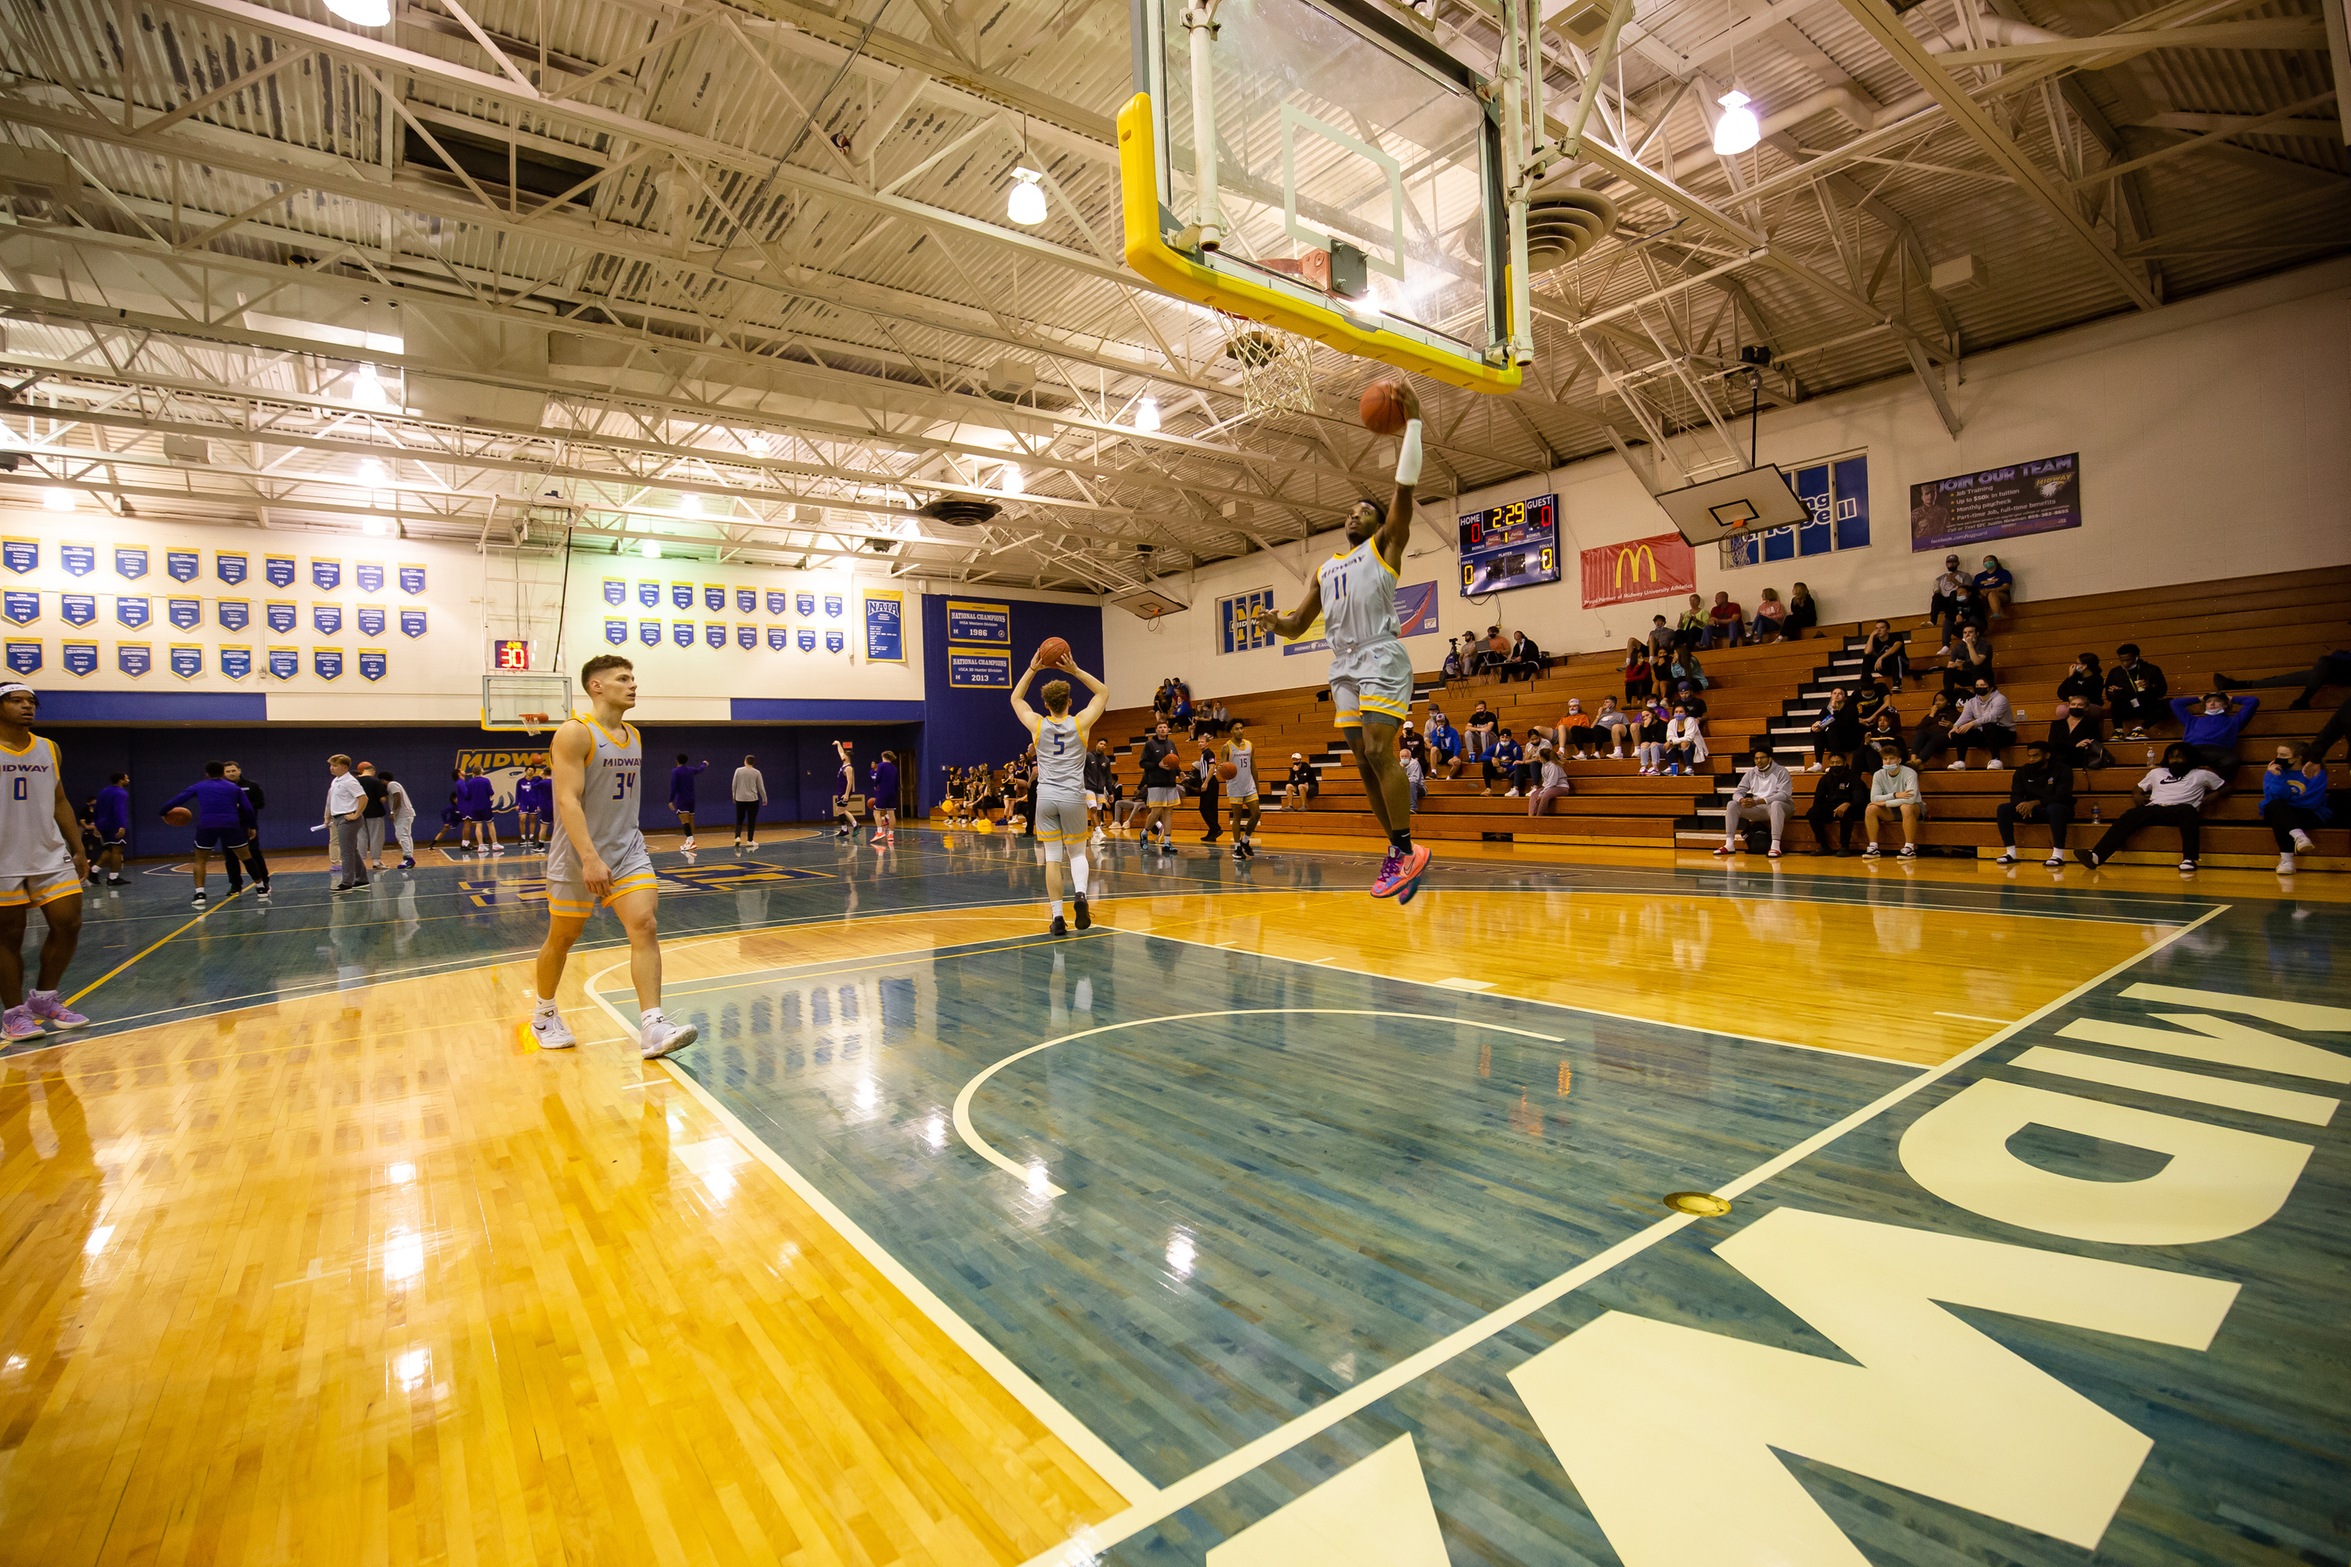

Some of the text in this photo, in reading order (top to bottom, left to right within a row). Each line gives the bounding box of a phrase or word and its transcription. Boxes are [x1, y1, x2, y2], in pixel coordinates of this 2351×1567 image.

[1939, 456, 2072, 493] JOIN OUR TEAM
[2036, 474, 2072, 486] MIDWAY
[1967, 486, 1993, 494] Training
[1999, 489, 2020, 497] tuition
[1527, 496, 1551, 509] GUEST
[1957, 498, 2011, 513] Monthly paycheck
[1957, 511, 1986, 520] Part-time
[2029, 499, 2056, 509] benefits
[1460, 514, 1480, 526] HOME
[1493, 502, 1525, 528] 2:29
[1541, 506, 1551, 527] 0
[1472, 523, 1481, 543] 0
[1321, 554, 1366, 579] MIDWAY
[1542, 548, 1552, 570] 0
[1464, 564, 1474, 585] 0
[1334, 572, 1348, 600] 11
[1623, 590, 1643, 599] Midway
[1644, 587, 1670, 596] University
[1670, 583, 1694, 591] Athletics
[868, 601, 899, 618] NAIA
[952, 612, 1006, 622] NATIONAL CHAMPIONS
[501, 648, 524, 668] 30
[1052, 733, 1066, 756] 5
[0, 764, 49, 772] IDWAY
[1240, 758, 1248, 768] 15
[14, 777, 27, 800] 0
[612, 773, 636, 800] 34
